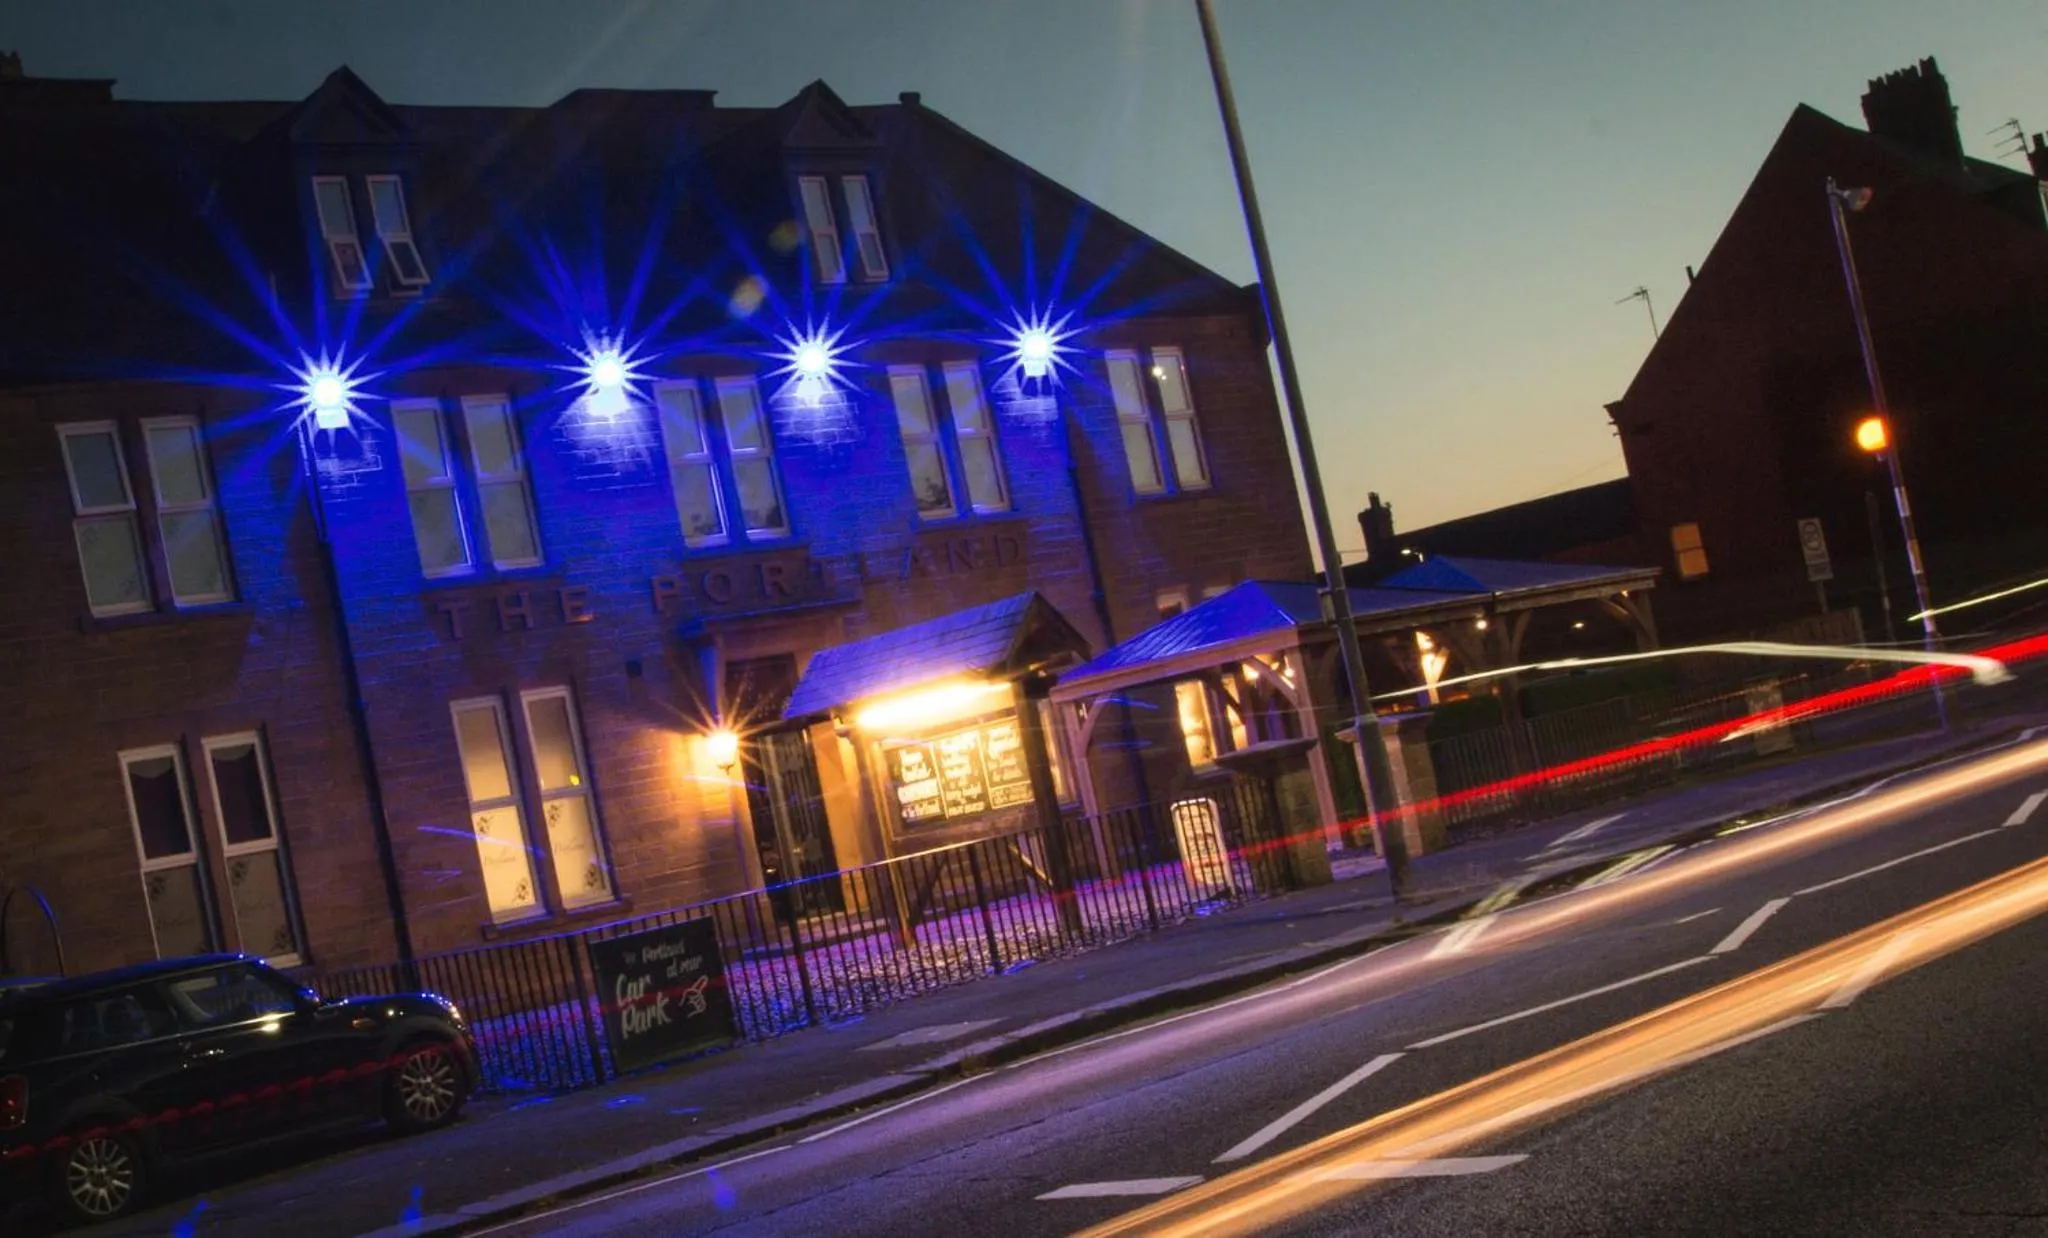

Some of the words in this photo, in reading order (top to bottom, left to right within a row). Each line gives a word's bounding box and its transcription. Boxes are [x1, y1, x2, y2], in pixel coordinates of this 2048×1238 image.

[436, 586, 596, 640] THE
[616, 973, 652, 1007] Car
[621, 992, 672, 1039] Park
